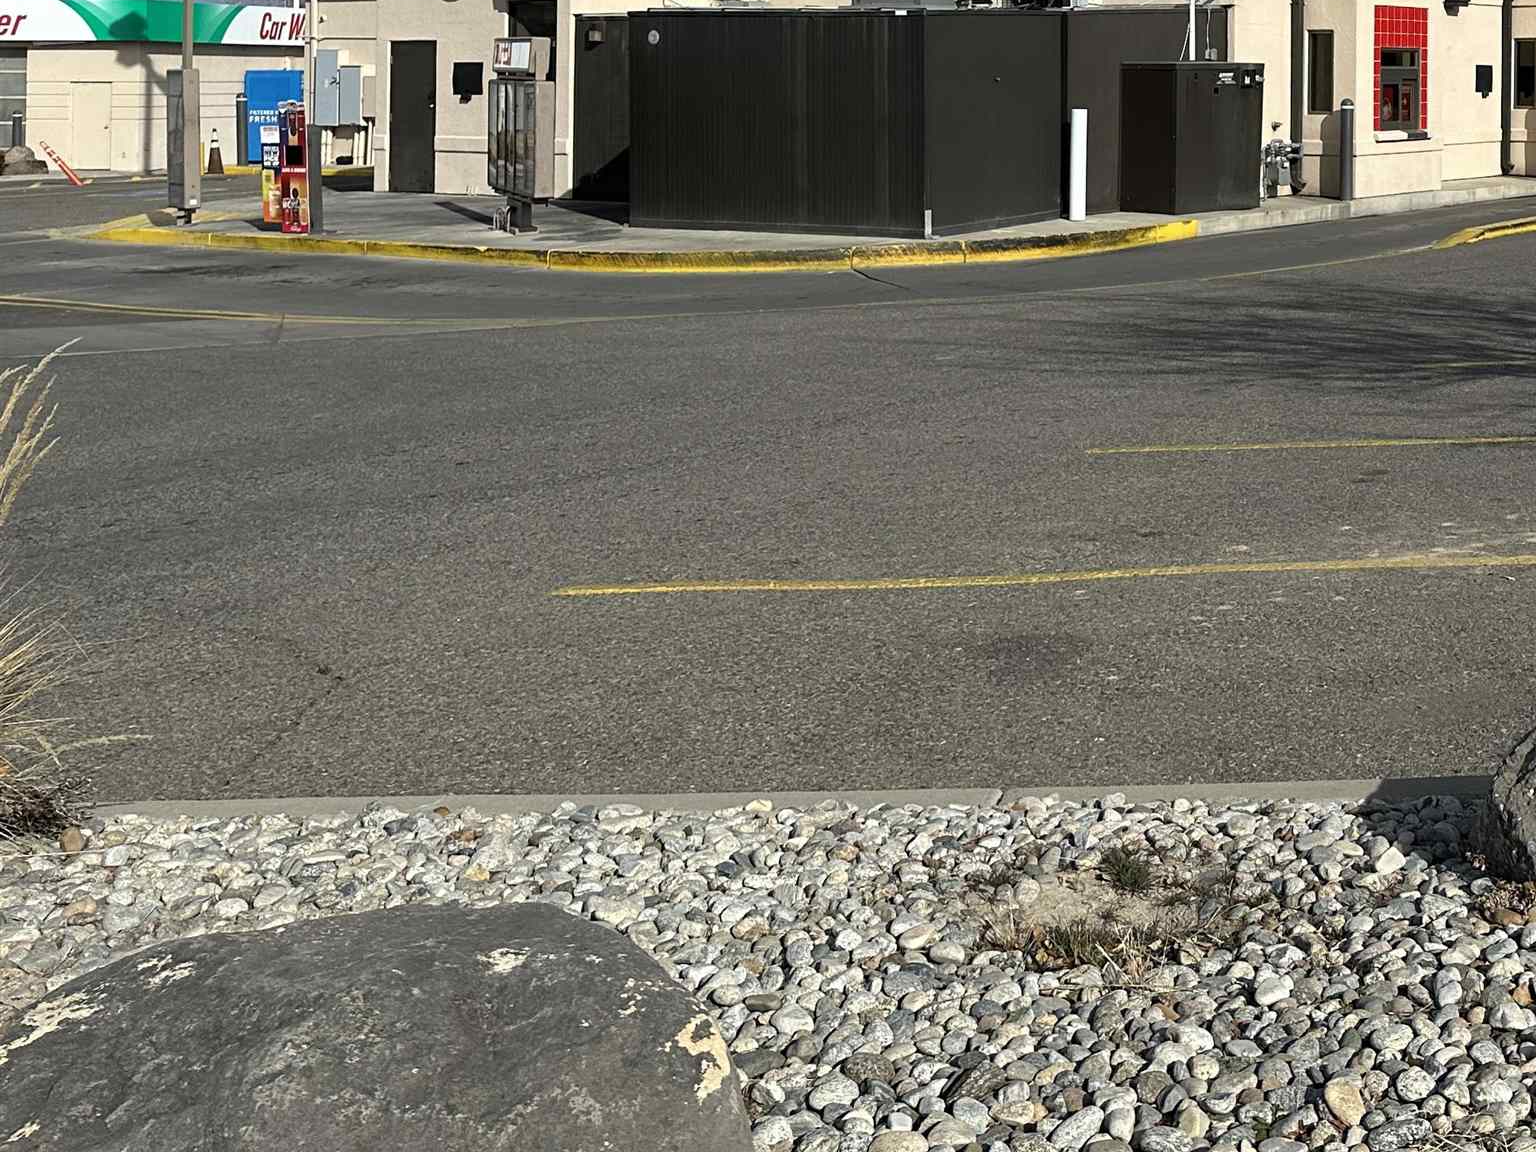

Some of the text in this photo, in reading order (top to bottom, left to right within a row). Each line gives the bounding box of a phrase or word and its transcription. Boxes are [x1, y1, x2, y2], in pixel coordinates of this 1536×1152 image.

[260, 12, 306, 40] Car W
[249, 115, 278, 124] FRESH
